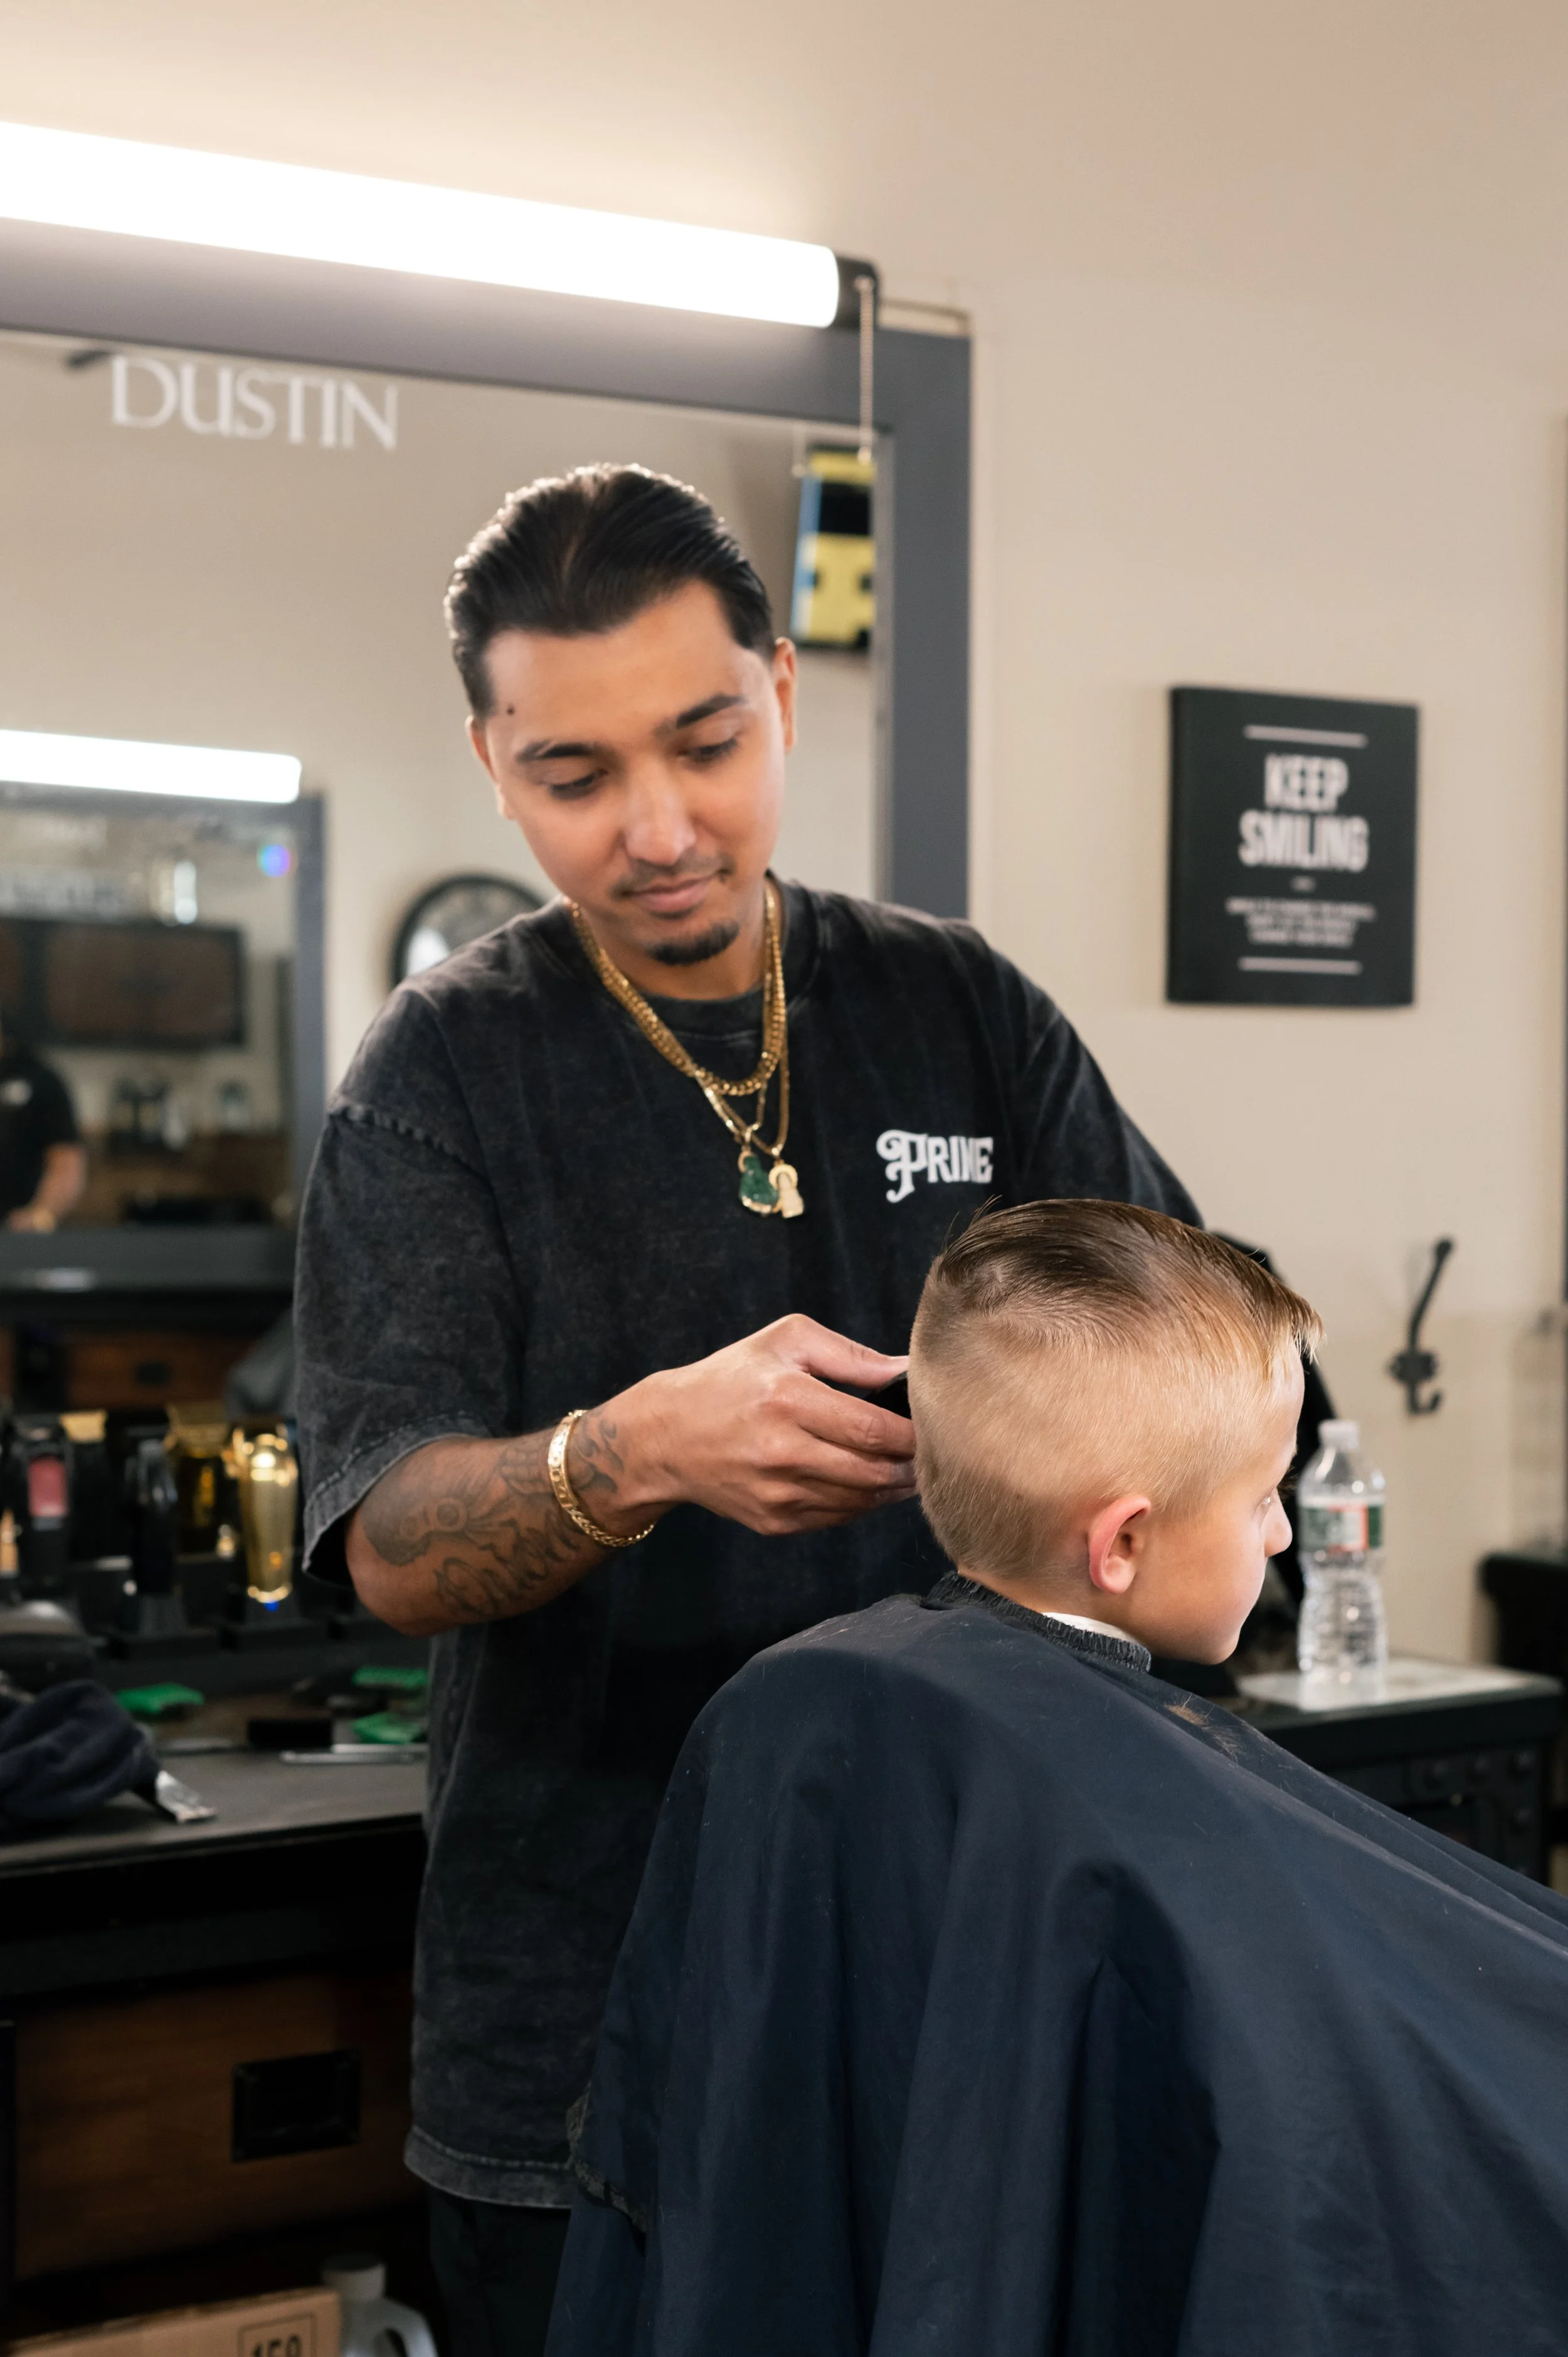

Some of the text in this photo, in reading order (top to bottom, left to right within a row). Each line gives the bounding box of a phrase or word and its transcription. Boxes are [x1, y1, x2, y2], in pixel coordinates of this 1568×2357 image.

[111, 354, 398, 448] DUSTIN
[1265, 754, 1348, 812] KEEP
[1239, 810, 1369, 872] SMILING
